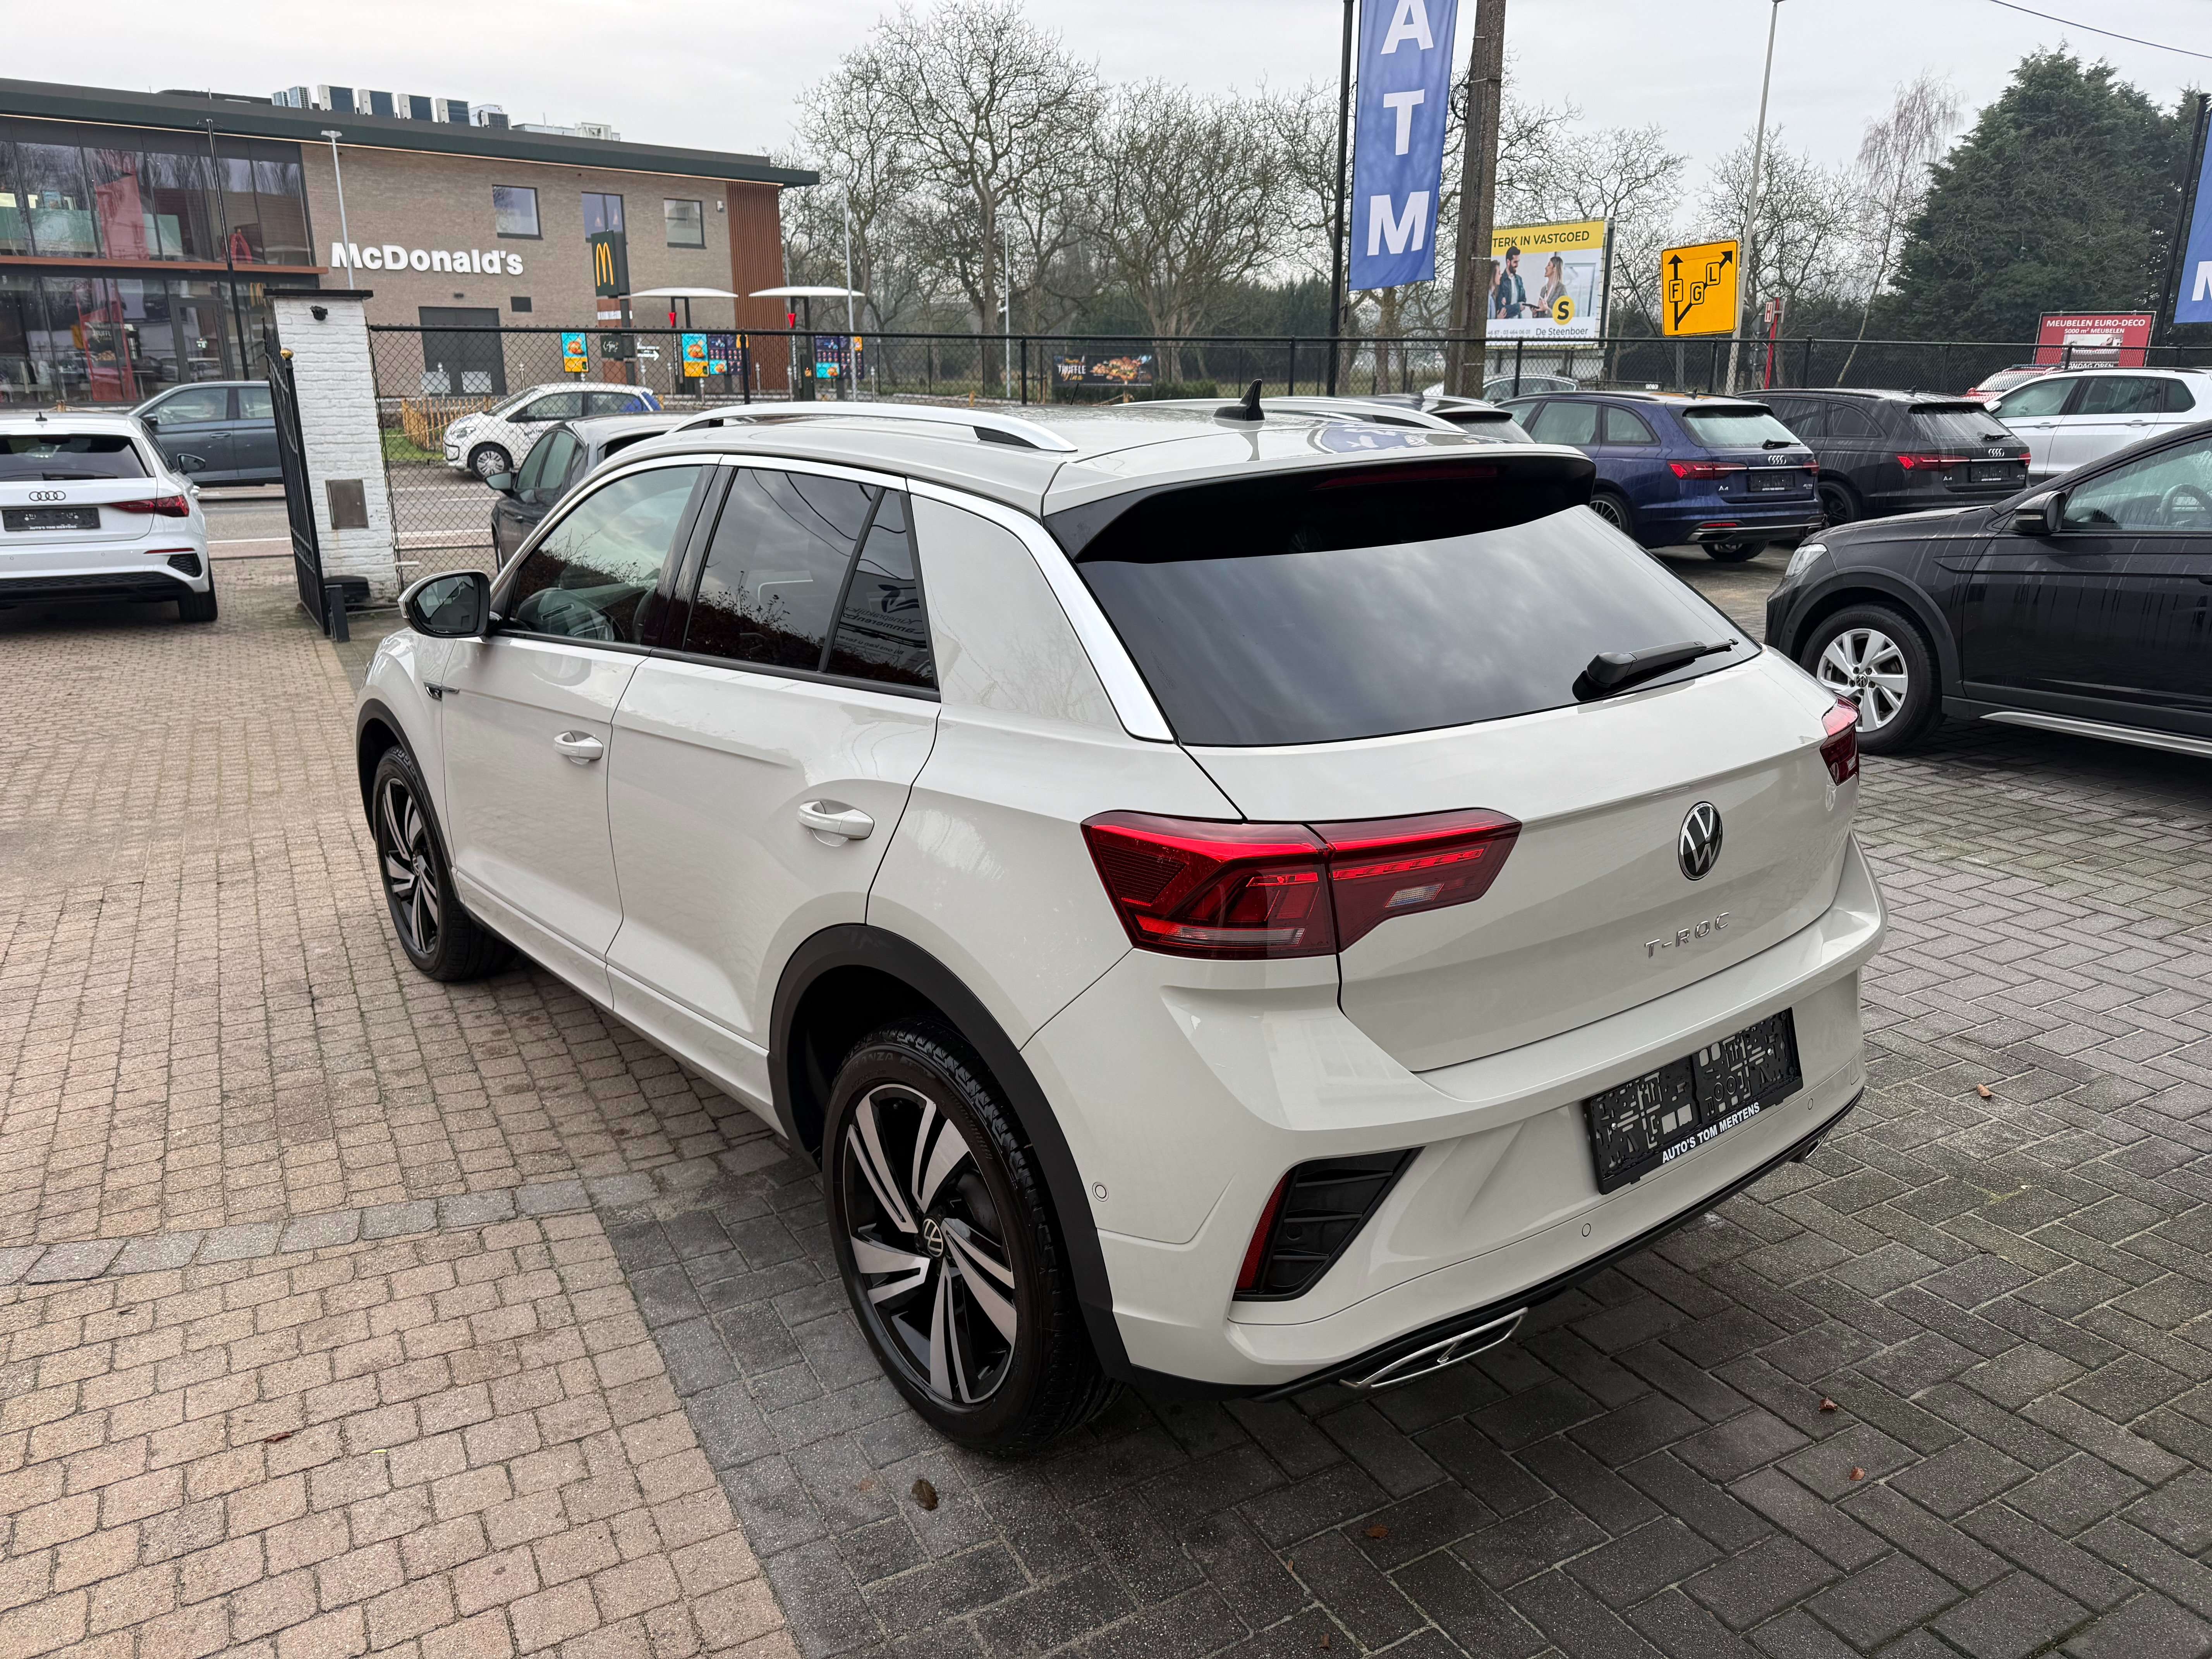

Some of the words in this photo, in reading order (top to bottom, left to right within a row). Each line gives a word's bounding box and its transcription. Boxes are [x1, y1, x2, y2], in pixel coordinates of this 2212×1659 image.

[1492, 236, 1518, 247] TERK
[1520, 235, 1530, 246] IN
[1534, 230, 1590, 244] VASTGOED
[331, 242, 524, 275] McDonald's
[1709, 266, 1717, 282] L
[1672, 283, 1680, 299] F
[1693, 285, 1702, 301] G
[1548, 327, 1588, 335] Steenboer
[1644, 912, 1729, 959] T-ROC
[1662, 1136, 1696, 1163] AUTO'S
[1697, 1124, 1718, 1144] TOM
[1719, 1102, 1760, 1133] MERTENS
